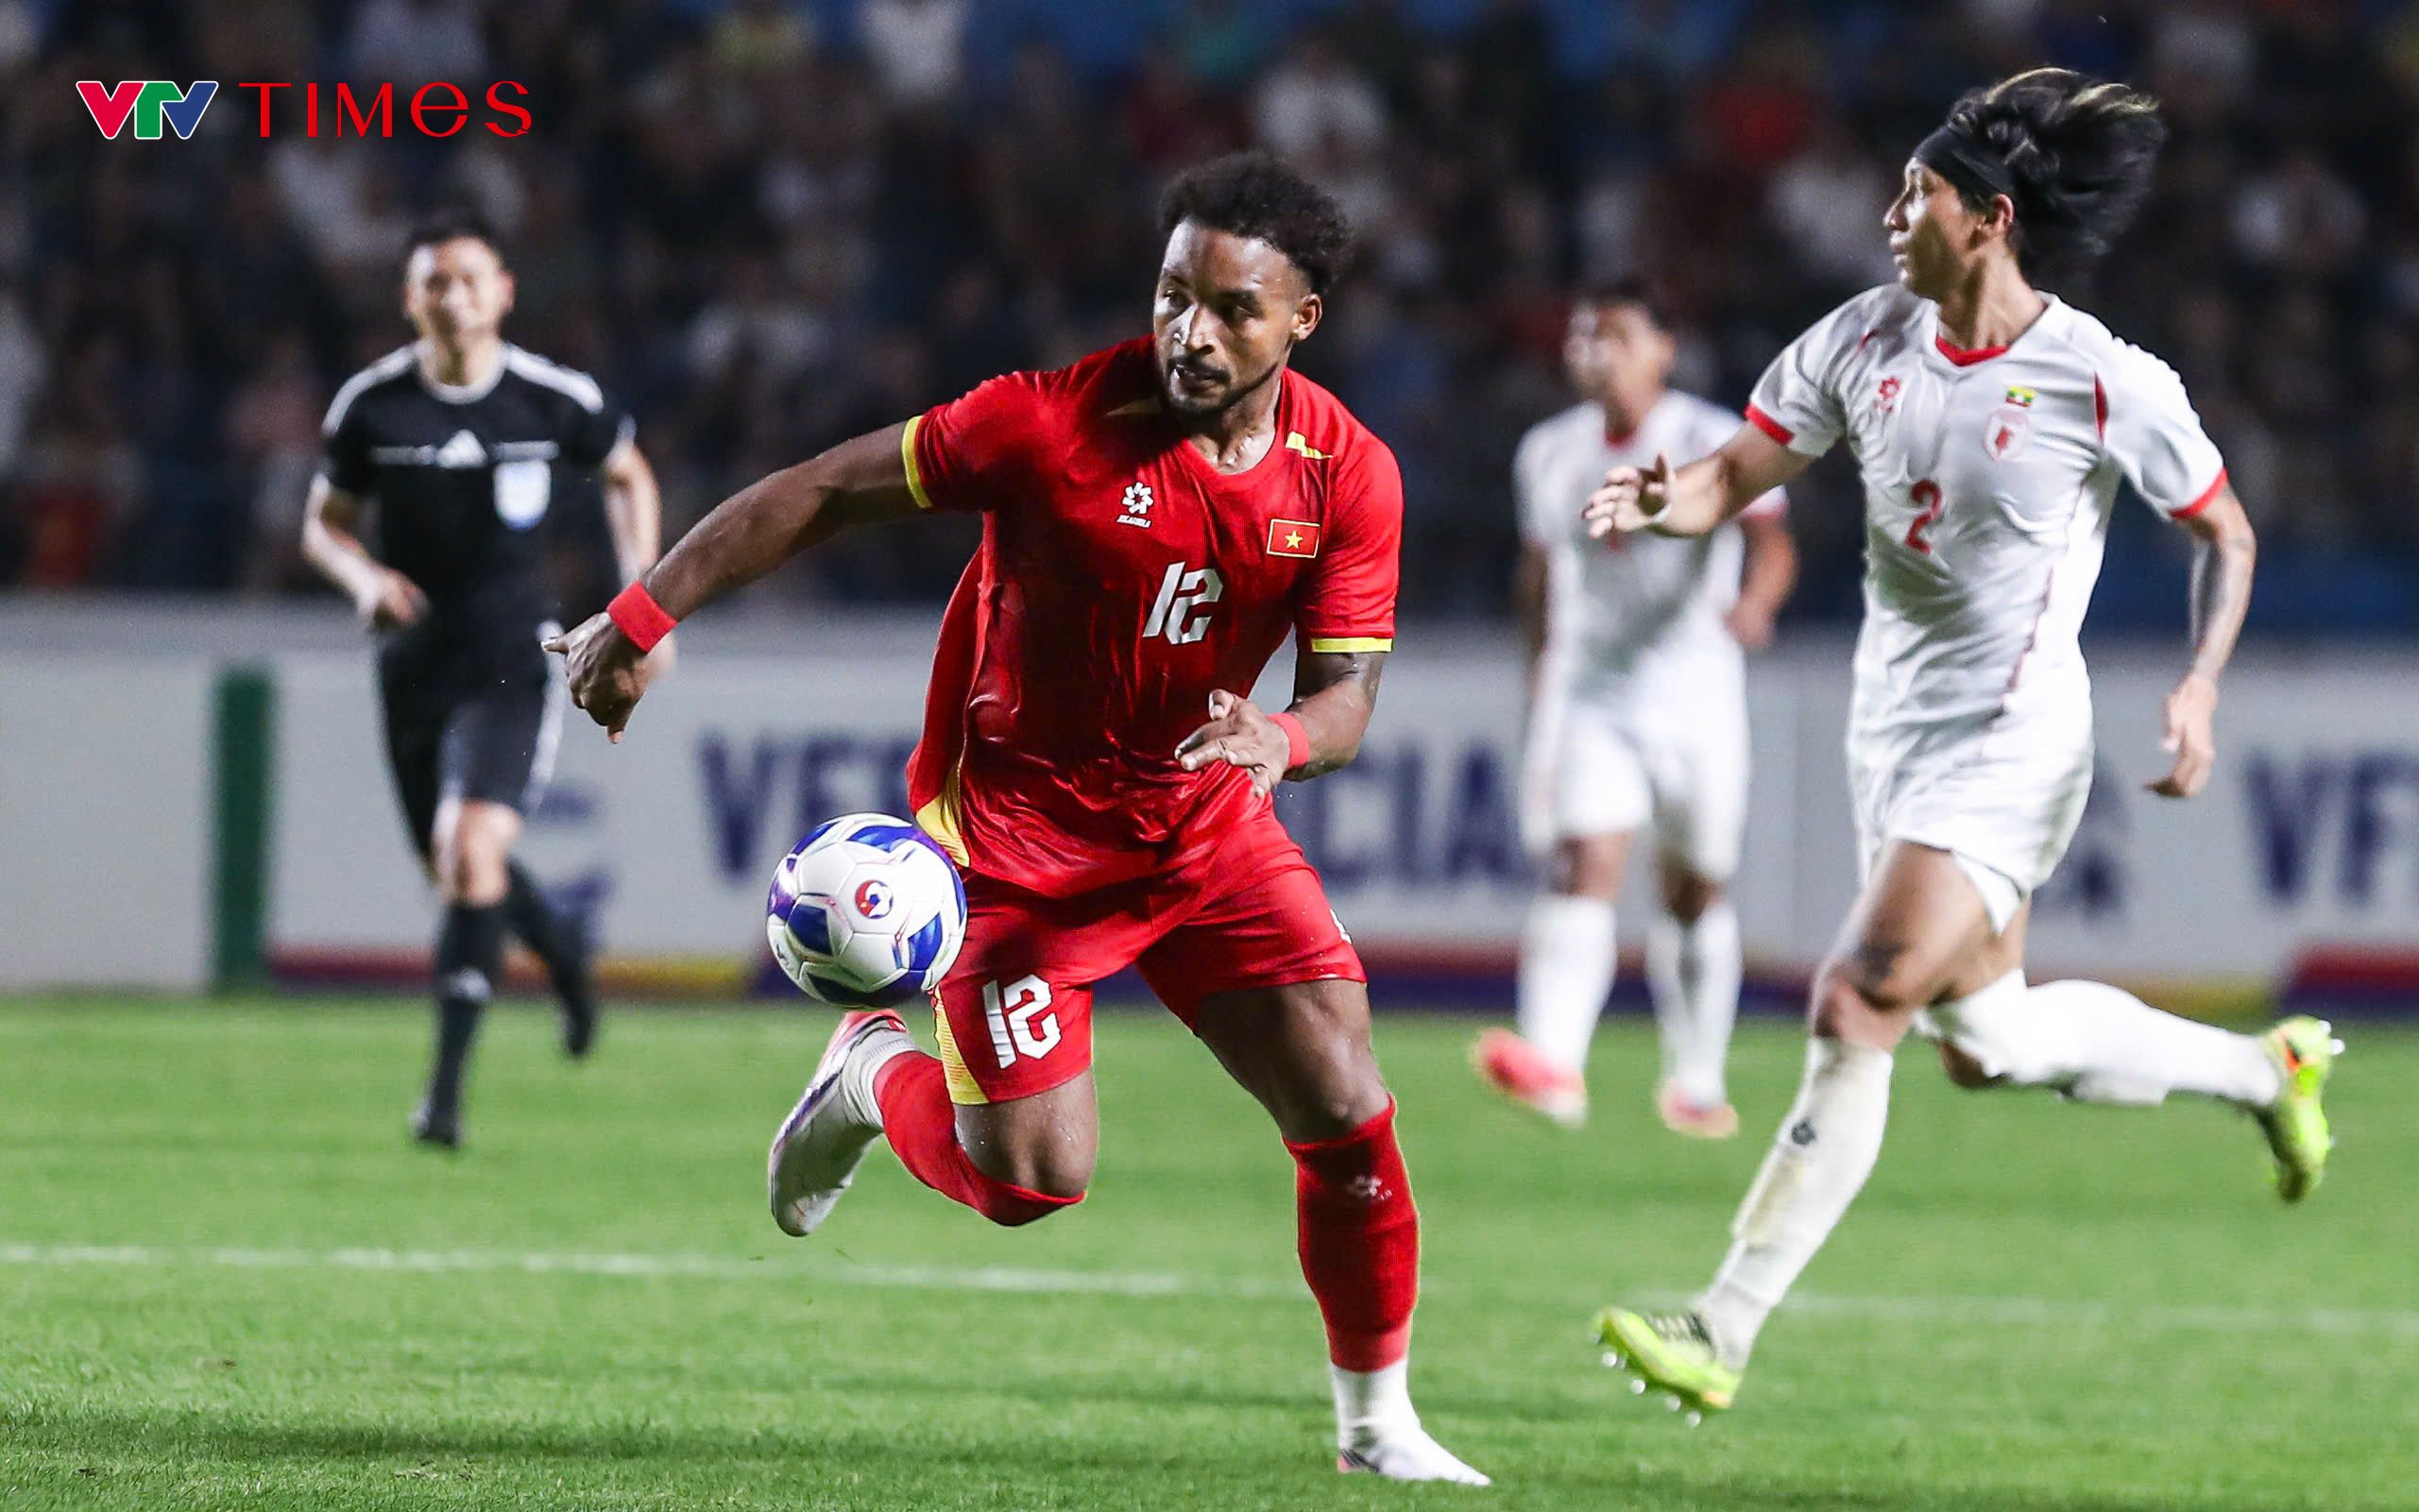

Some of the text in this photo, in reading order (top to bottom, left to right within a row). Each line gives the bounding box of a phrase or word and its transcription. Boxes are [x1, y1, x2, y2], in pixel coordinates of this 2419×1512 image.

[1904, 479, 1942, 555] 2
[1142, 561, 1224, 645] 12
[982, 974, 1063, 1070] 12
